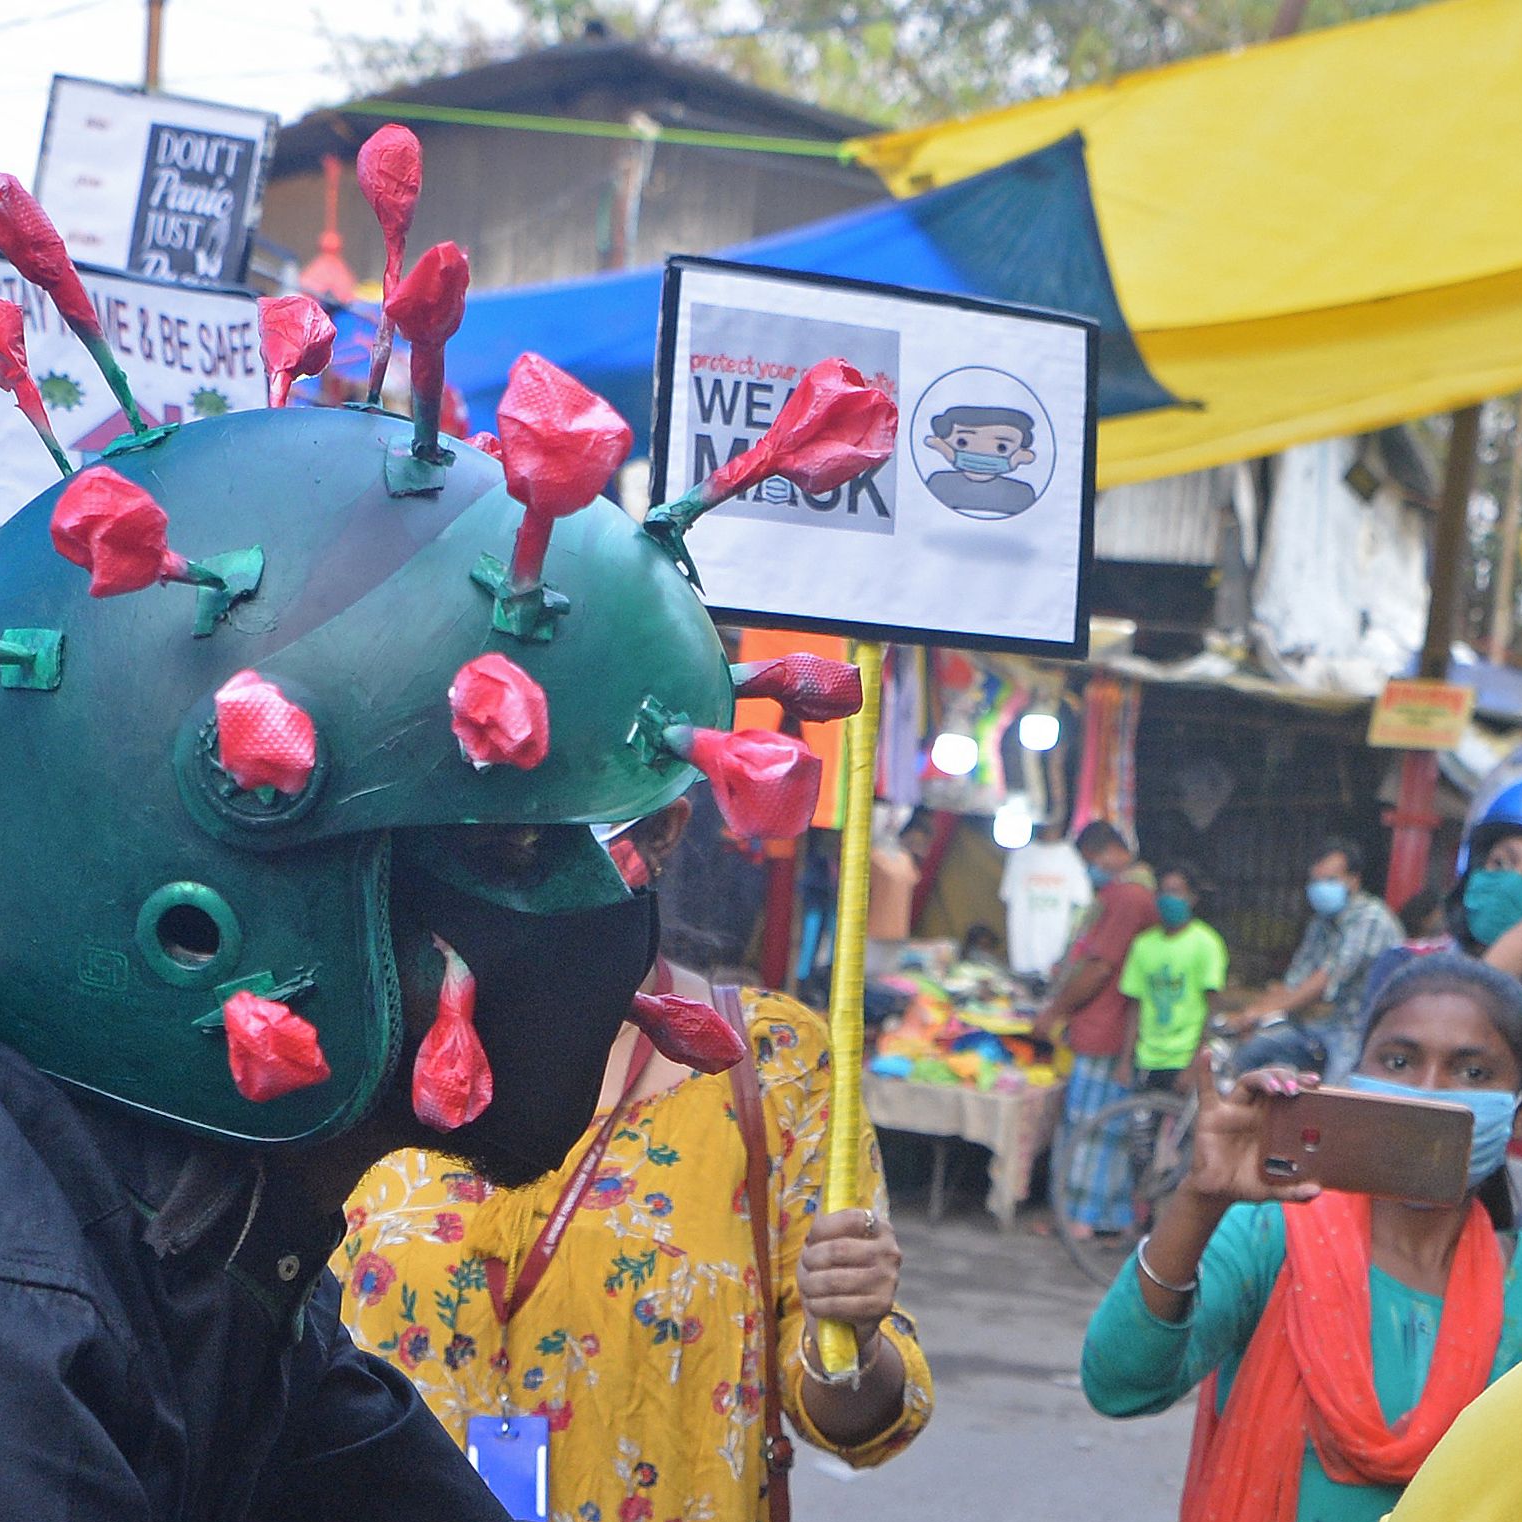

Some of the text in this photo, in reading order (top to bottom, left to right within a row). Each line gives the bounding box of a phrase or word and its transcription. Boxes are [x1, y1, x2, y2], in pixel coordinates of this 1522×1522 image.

[149, 166, 234, 220] Panic
[142, 212, 205, 250] JUST
[139, 306, 154, 361] &
[160, 311, 193, 373] BE
[198, 319, 256, 378] SAFE
[690, 352, 757, 376] protect
[757, 361, 797, 381] your
